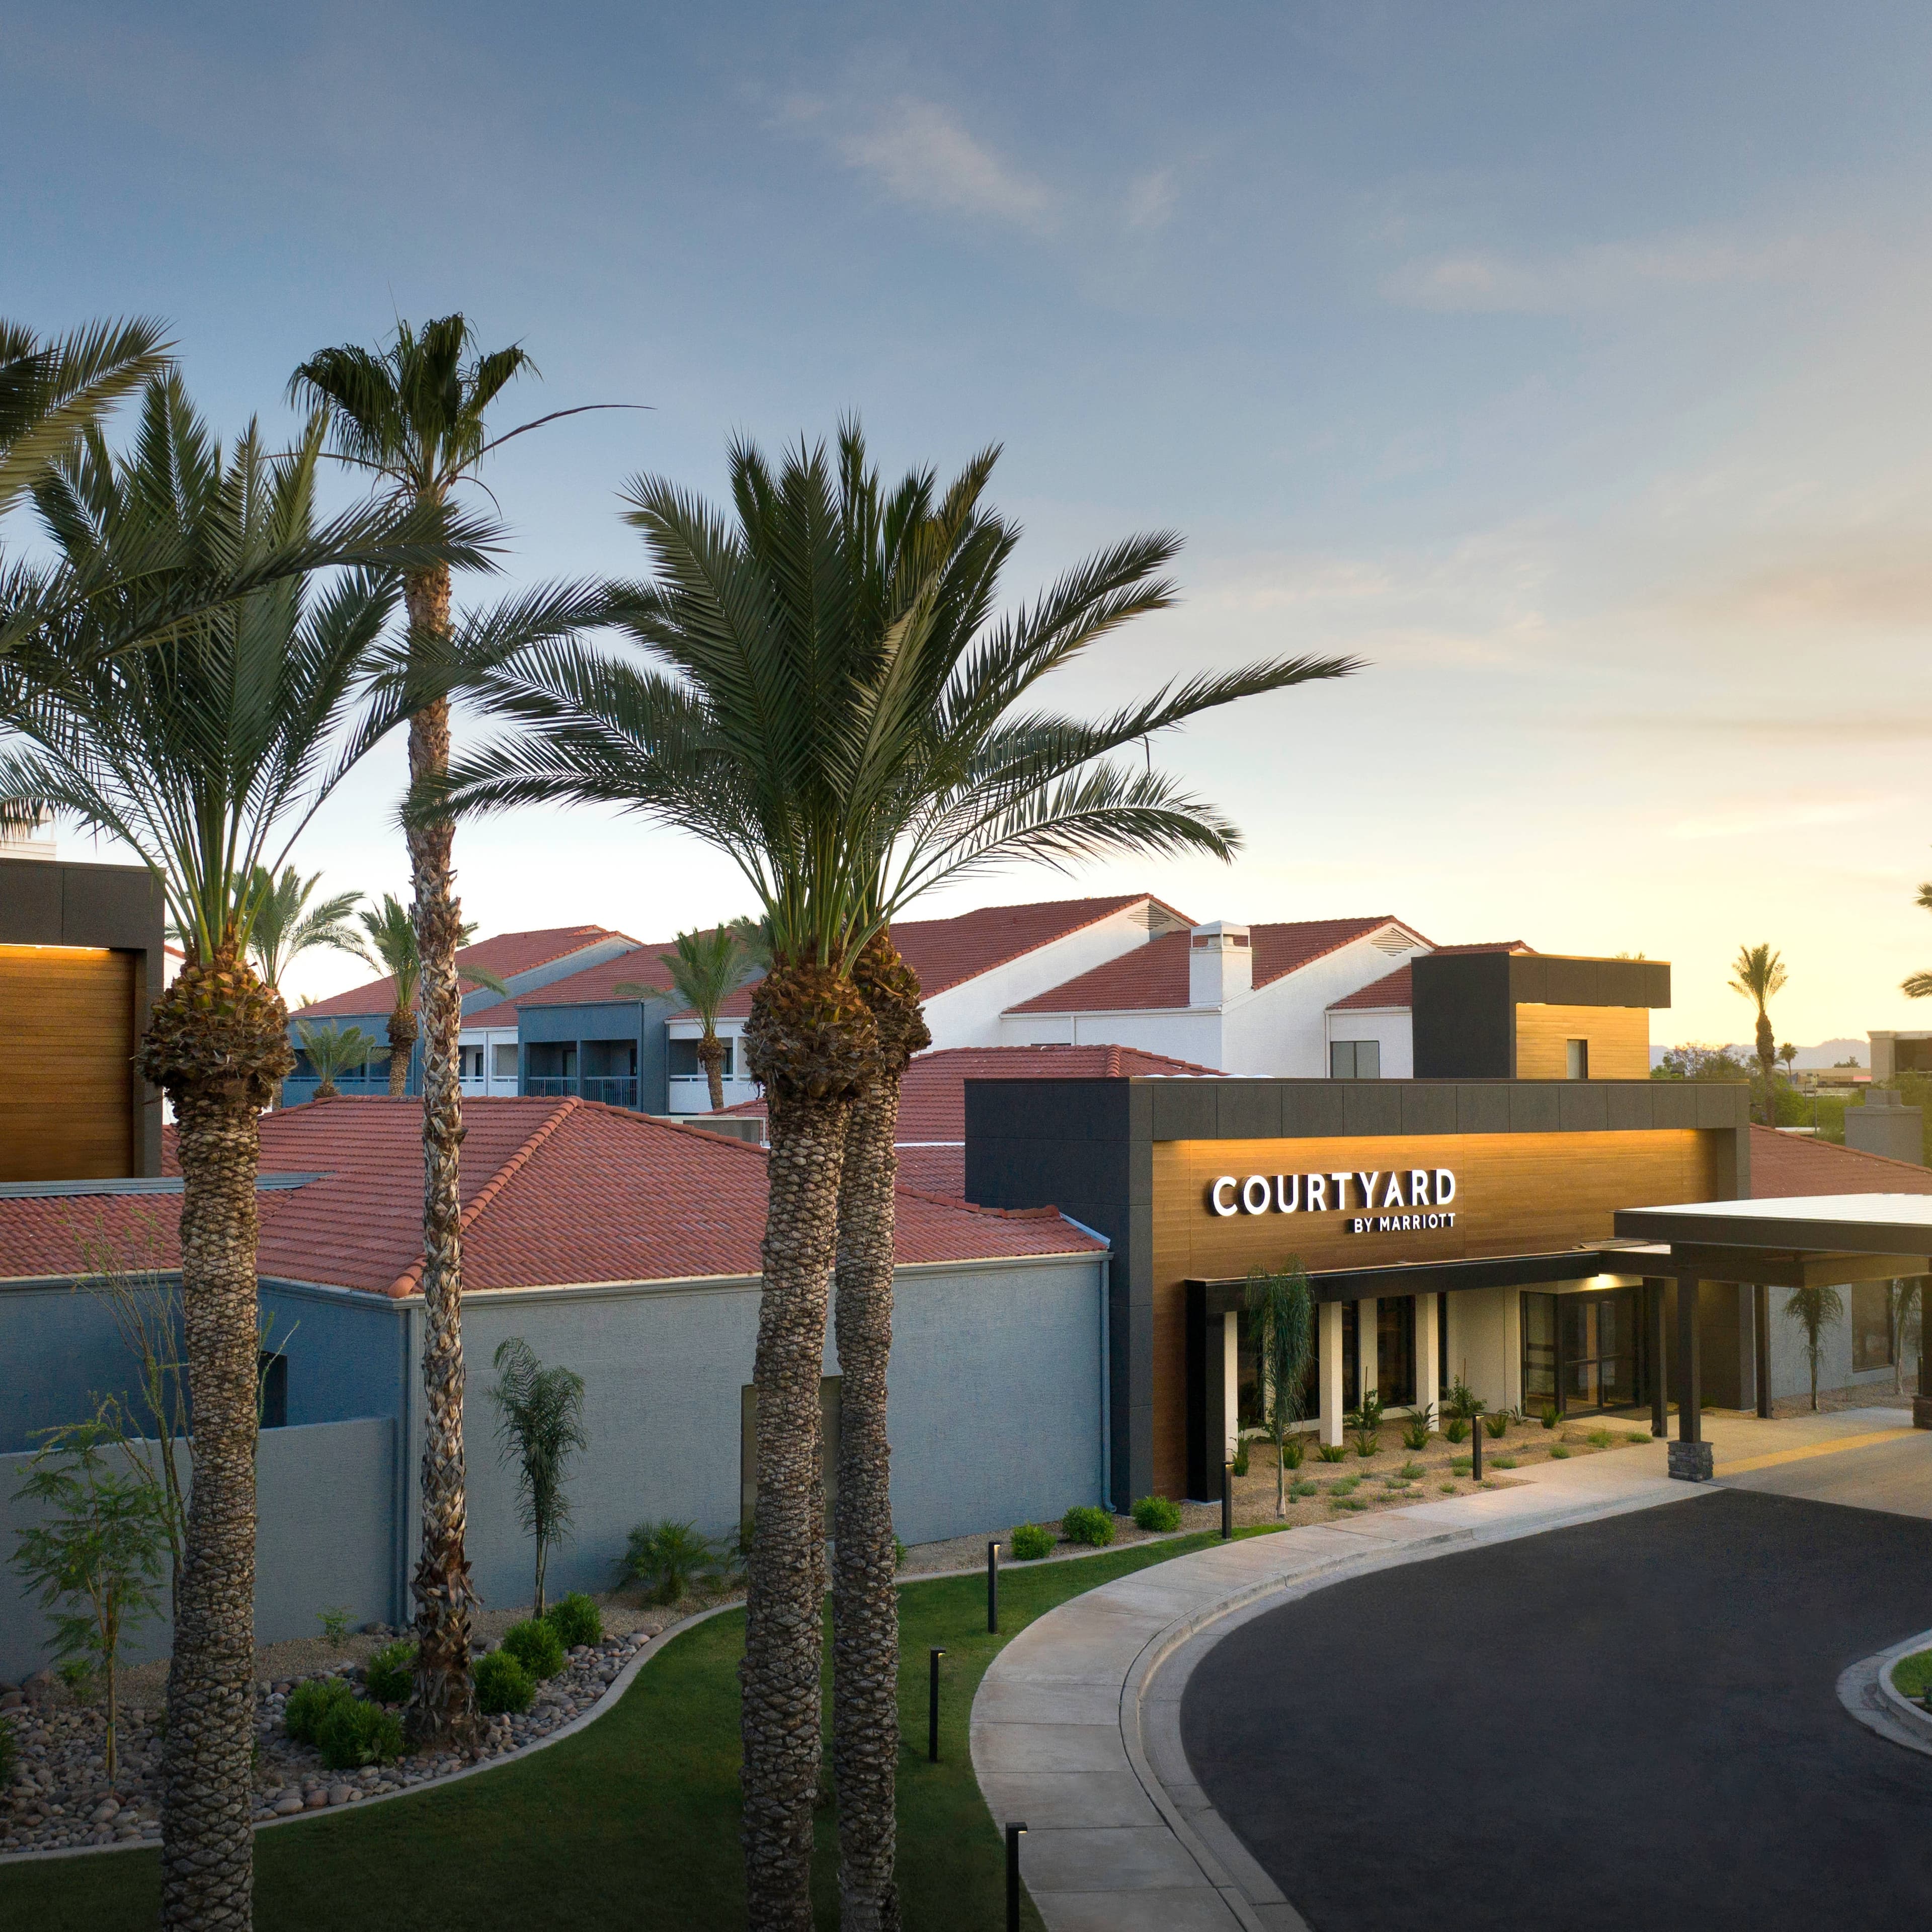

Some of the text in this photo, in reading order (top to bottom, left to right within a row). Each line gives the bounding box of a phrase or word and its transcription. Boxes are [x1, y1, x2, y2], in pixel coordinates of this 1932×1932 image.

[1212, 1168, 1456, 1217] COURTYARD
[1353, 1213, 1456, 1233] BY MARRIOTT
